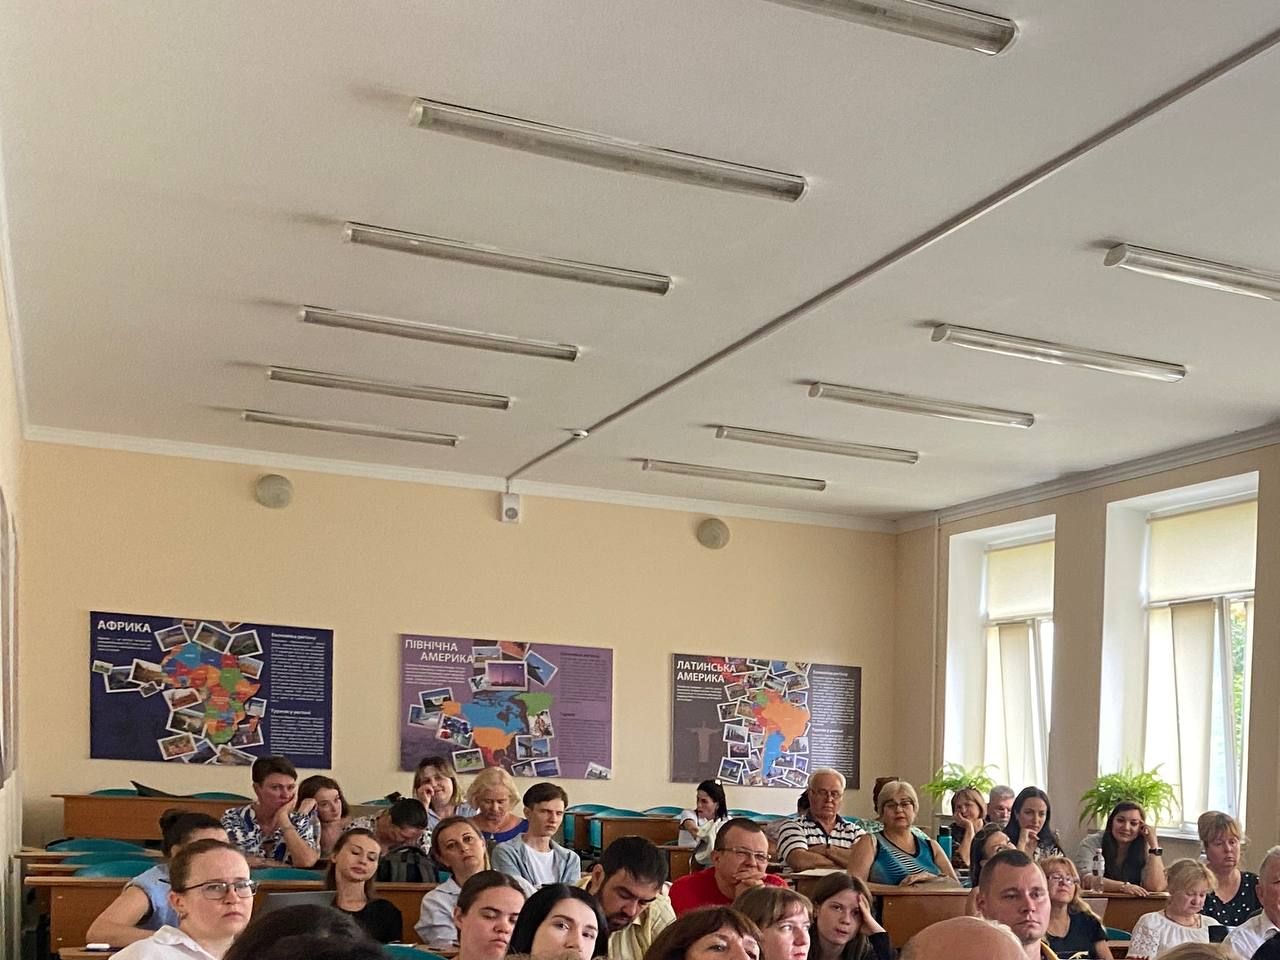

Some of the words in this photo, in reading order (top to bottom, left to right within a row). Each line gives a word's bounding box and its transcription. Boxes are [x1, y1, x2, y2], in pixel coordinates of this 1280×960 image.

[97, 620, 152, 633] АФРИКА
[404, 639, 458, 652] ПІВНІЧНА
[420, 651, 474, 664] АМЕРИКА
[676, 660, 737, 673] ЛАТИНСЬКА
[676, 671, 725, 683] АМЕРИКА
